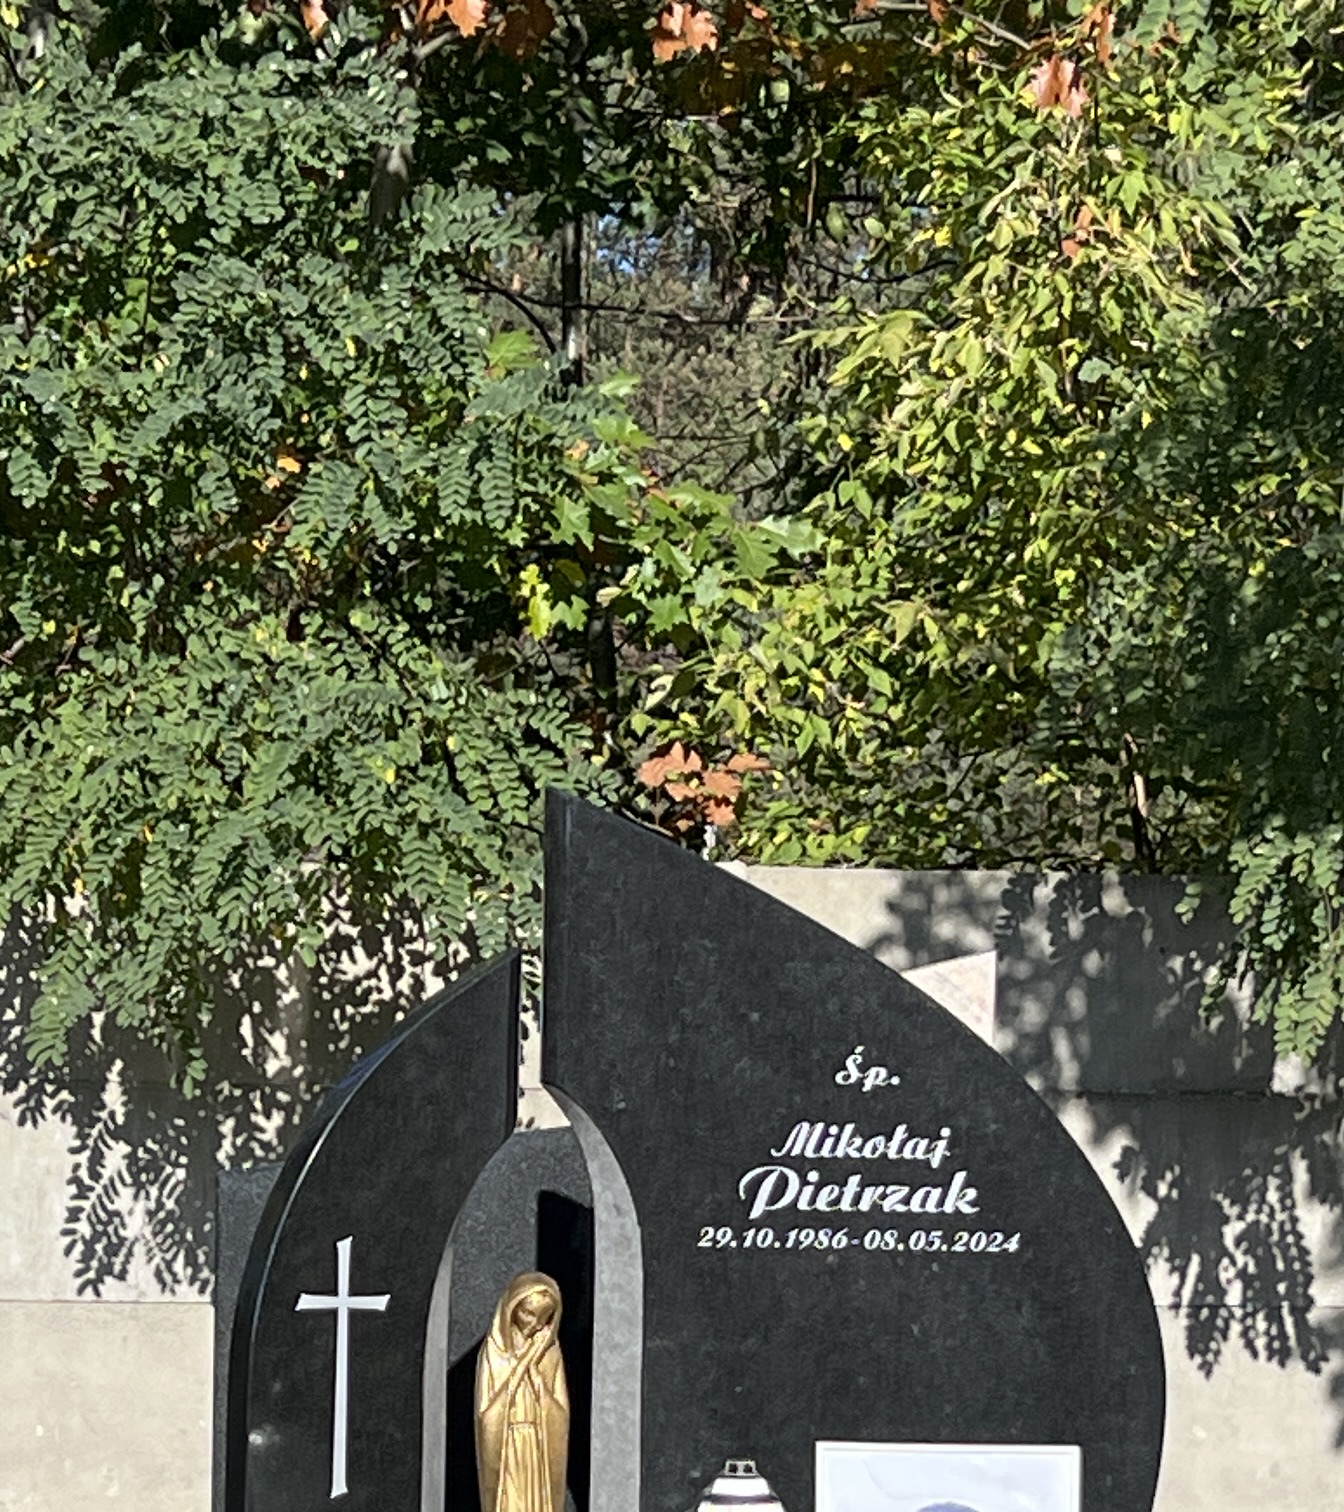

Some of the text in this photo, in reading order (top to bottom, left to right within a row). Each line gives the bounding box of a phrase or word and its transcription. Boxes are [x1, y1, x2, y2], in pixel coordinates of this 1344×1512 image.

[835, 1045, 900, 1092] Śp.
[770, 1121, 951, 1169] Mikołaj
[738, 1165, 981, 1220] Pietrzak
